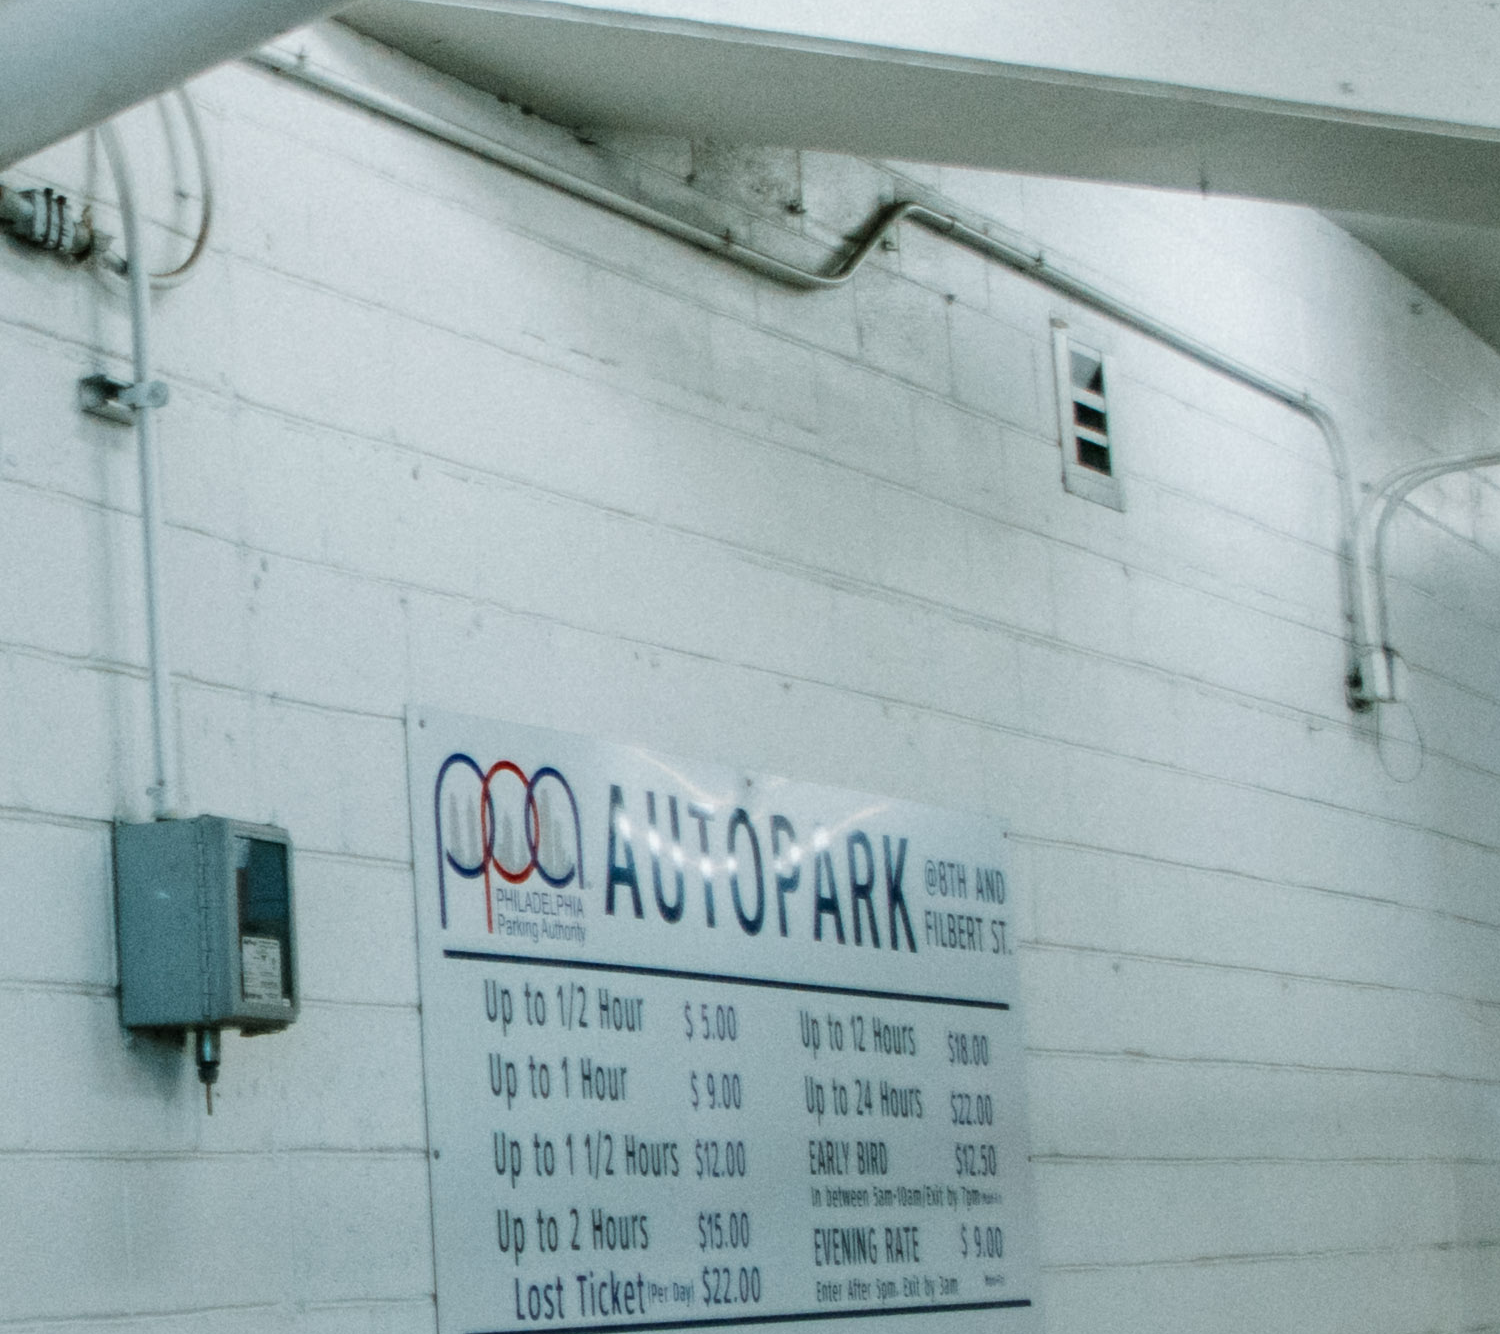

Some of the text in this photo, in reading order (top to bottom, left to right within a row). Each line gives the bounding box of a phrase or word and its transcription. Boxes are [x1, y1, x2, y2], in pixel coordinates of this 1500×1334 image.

[605, 784, 918, 953] AUTOPARK
[925, 859, 1006, 906] @8TH AND
[496, 888, 584, 918] PHILADELPHIA
[497, 913, 587, 947] Parking Authority
[925, 909, 1014, 956] FILBERT ST.
[484, 979, 514, 1036] Up
[524, 982, 546, 1026] to
[556, 982, 590, 1030] 1/2
[598, 988, 644, 1033] Hour
[701, 1004, 738, 1043] 5.00
[800, 1009, 990, 1067] Up to 12 Hours $18.00
[488, 1052, 518, 1110] Up
[529, 1055, 551, 1100] to
[560, 1059, 570, 1099] 1
[581, 1059, 628, 1103] Hour
[706, 1073, 742, 1111] 9.00
[804, 1074, 994, 1129] Up to 24 Hours $22.00
[493, 1132, 747, 1188] Up to 1 1/2 Hours $12.00
[809, 1140, 997, 1177] EARLY BIRD $12.50
[825, 1185, 870, 1208] between
[947, 1185, 958, 1213] by
[497, 1208, 751, 1265] Up to 2 Hours $15.00
[814, 1226, 878, 1267] EVENING
[884, 1225, 920, 1263] RATE
[973, 1225, 1005, 1259] 9.00
[515, 1276, 565, 1322] Lost
[574, 1269, 646, 1319] Ticket
[702, 1266, 762, 1307] $22.00
[816, 1279, 843, 1304] Enter
[847, 1277, 872, 1302] After
[903, 1276, 920, 1298] Exit
[924, 1275, 935, 1302] by
